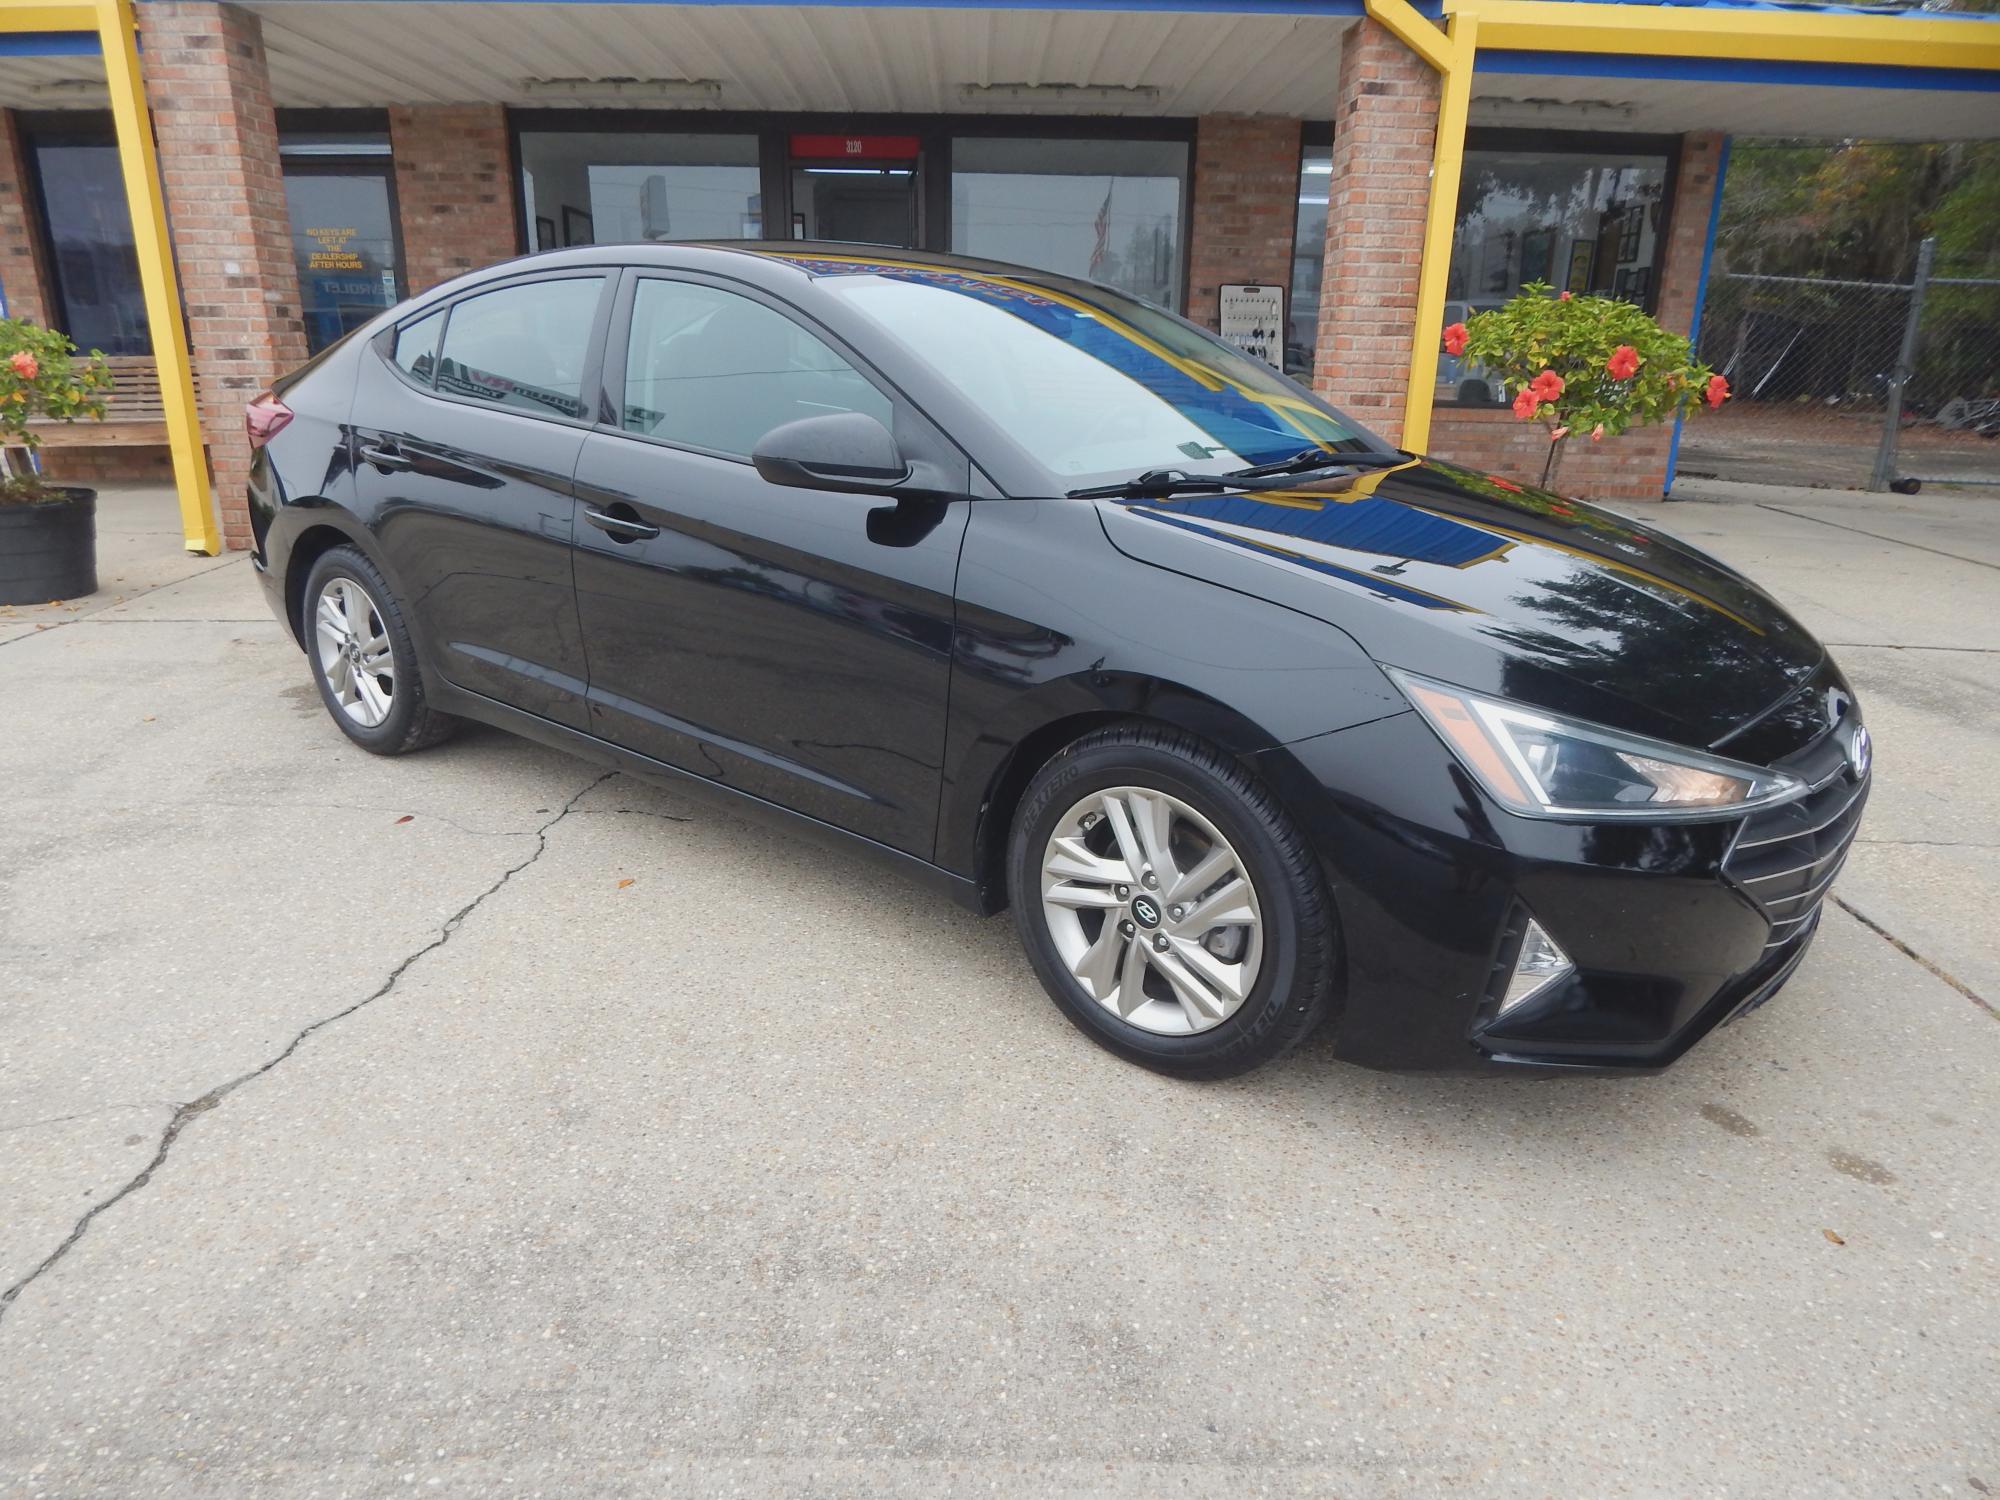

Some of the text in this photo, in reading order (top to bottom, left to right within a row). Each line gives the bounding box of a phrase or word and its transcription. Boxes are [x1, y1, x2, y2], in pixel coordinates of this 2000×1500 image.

[846, 140, 862, 153] 3120
[340, 228, 357, 236] ARE
[317, 236, 336, 244] LEFT
[327, 244, 342, 252] THE
[311, 252, 359, 260] DEALERSHIP
[309, 260, 363, 269] AFTER HOURS
